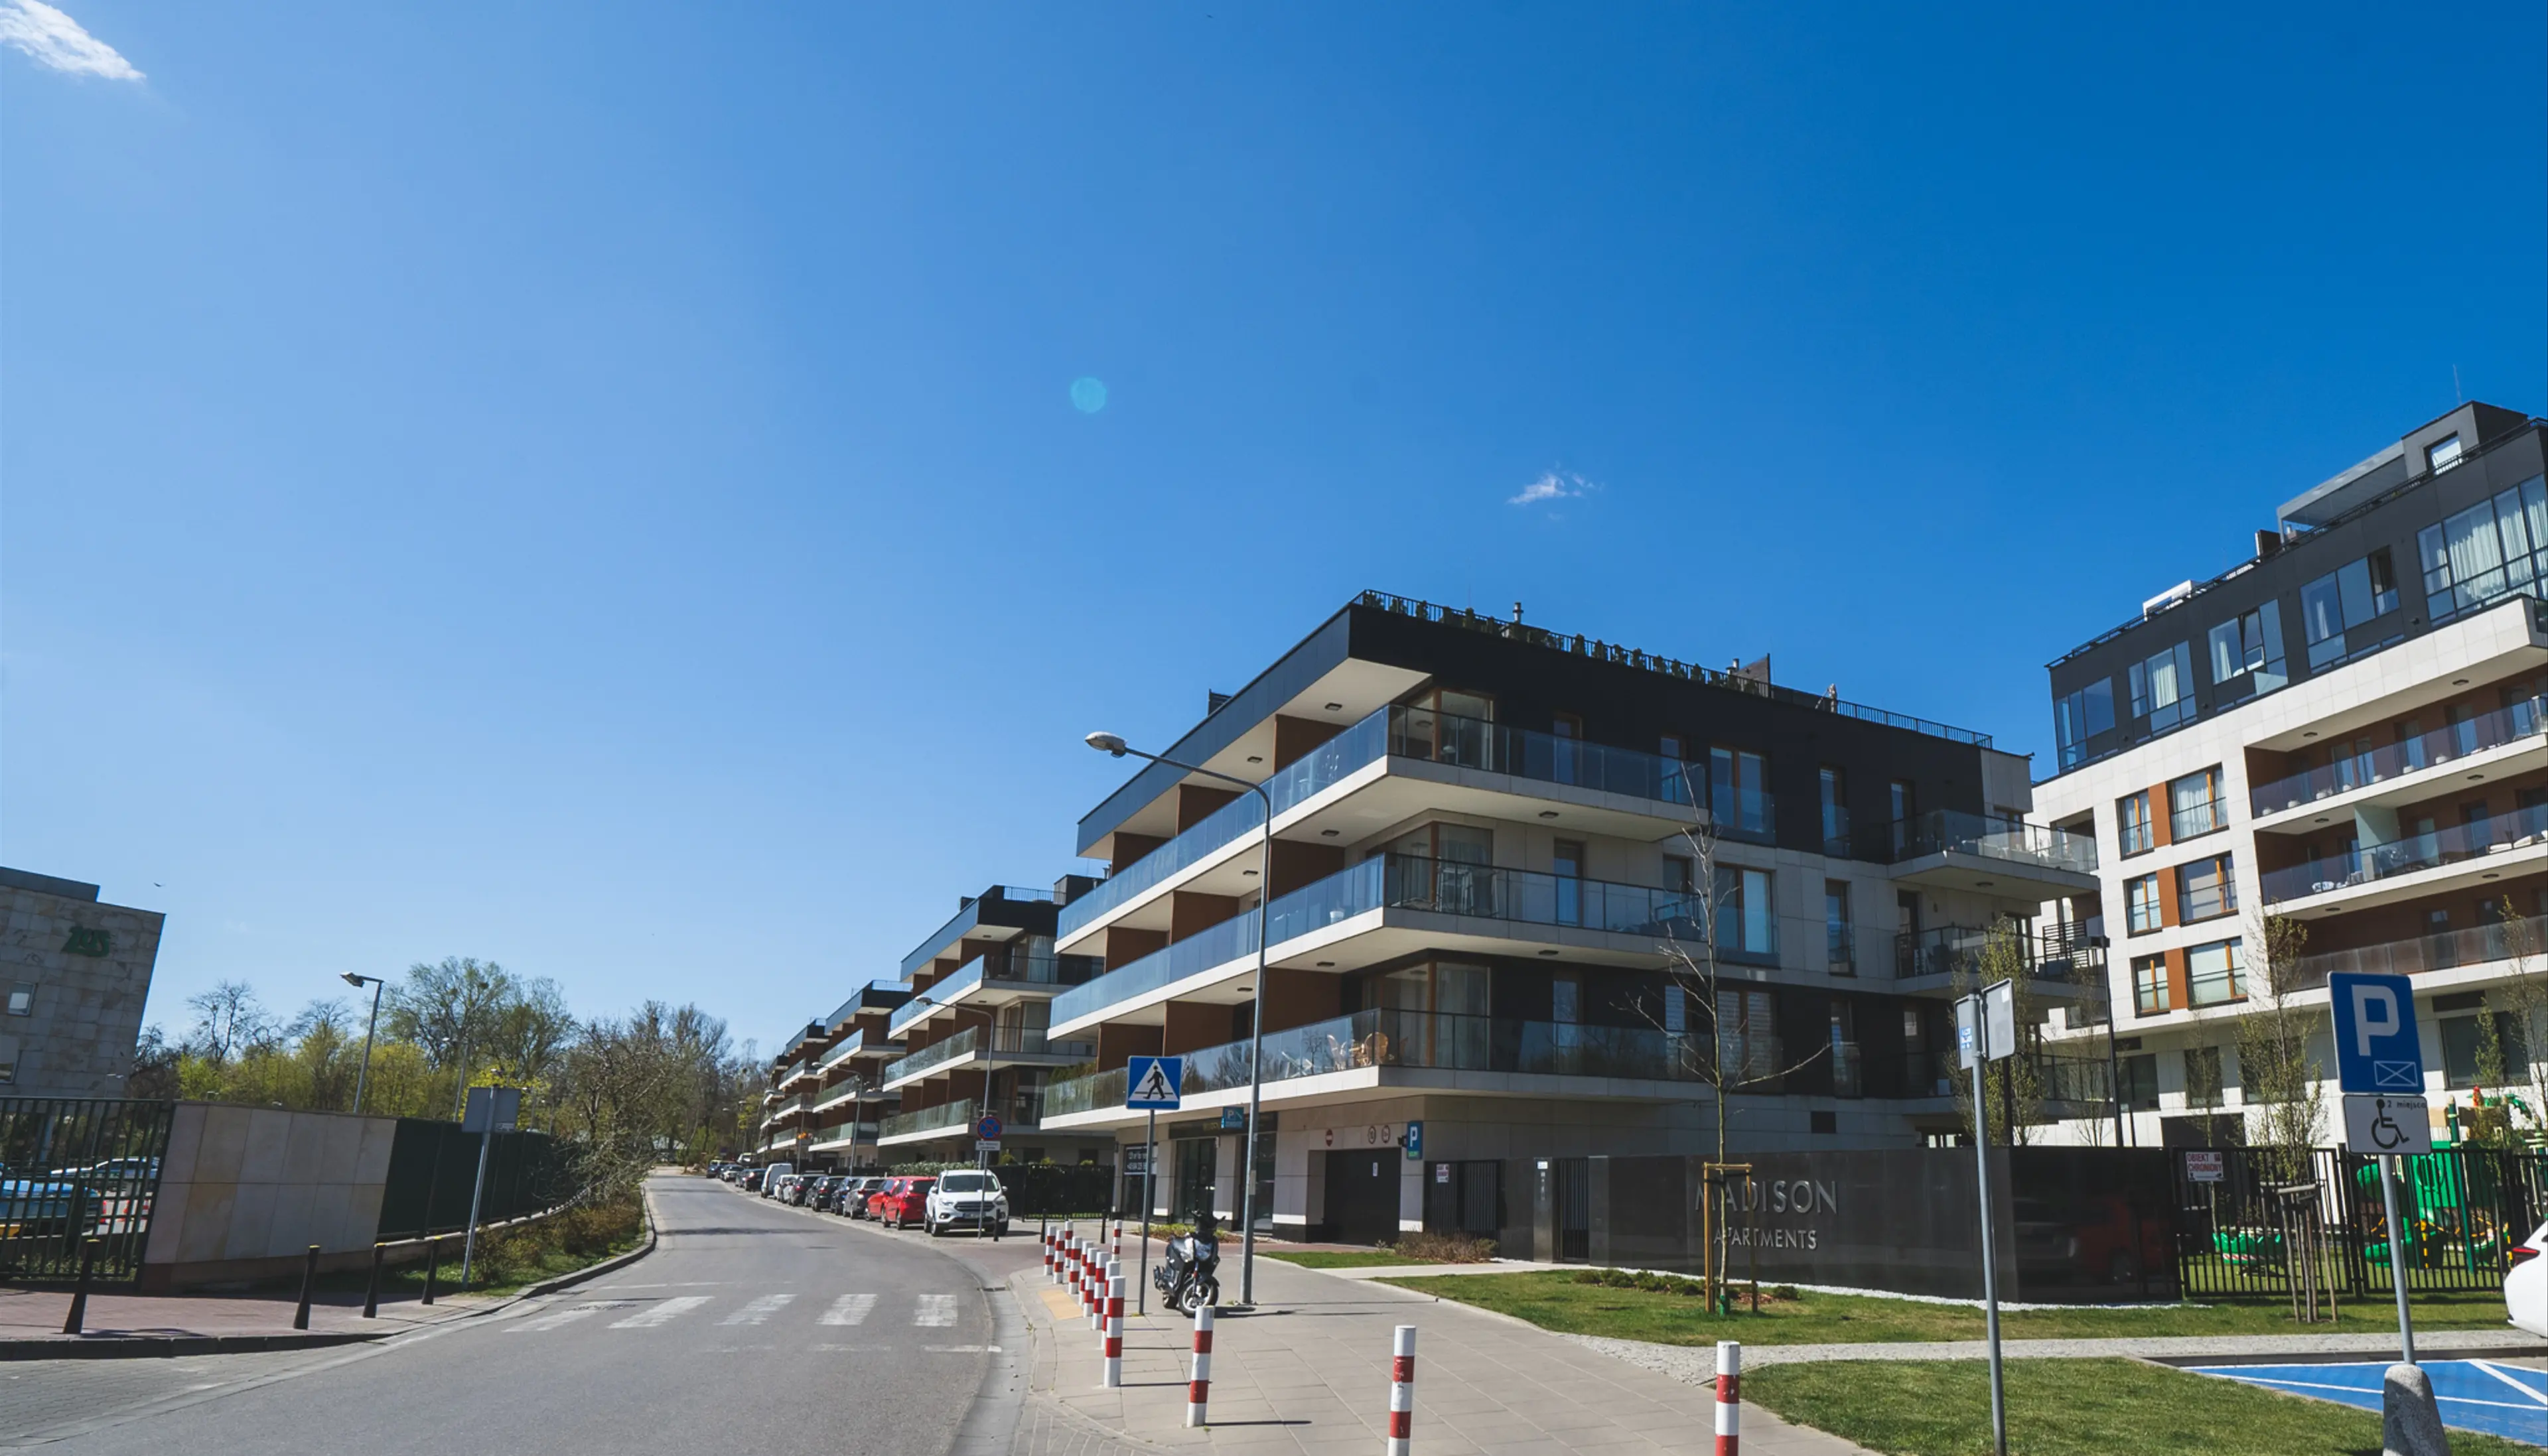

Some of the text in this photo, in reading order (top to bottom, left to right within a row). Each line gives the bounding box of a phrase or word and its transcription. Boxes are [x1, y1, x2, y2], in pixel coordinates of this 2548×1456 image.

[2351, 984, 2400, 1056] P
[2387, 1099, 2392, 1108] 2
[1409, 1126, 1418, 1148] P
